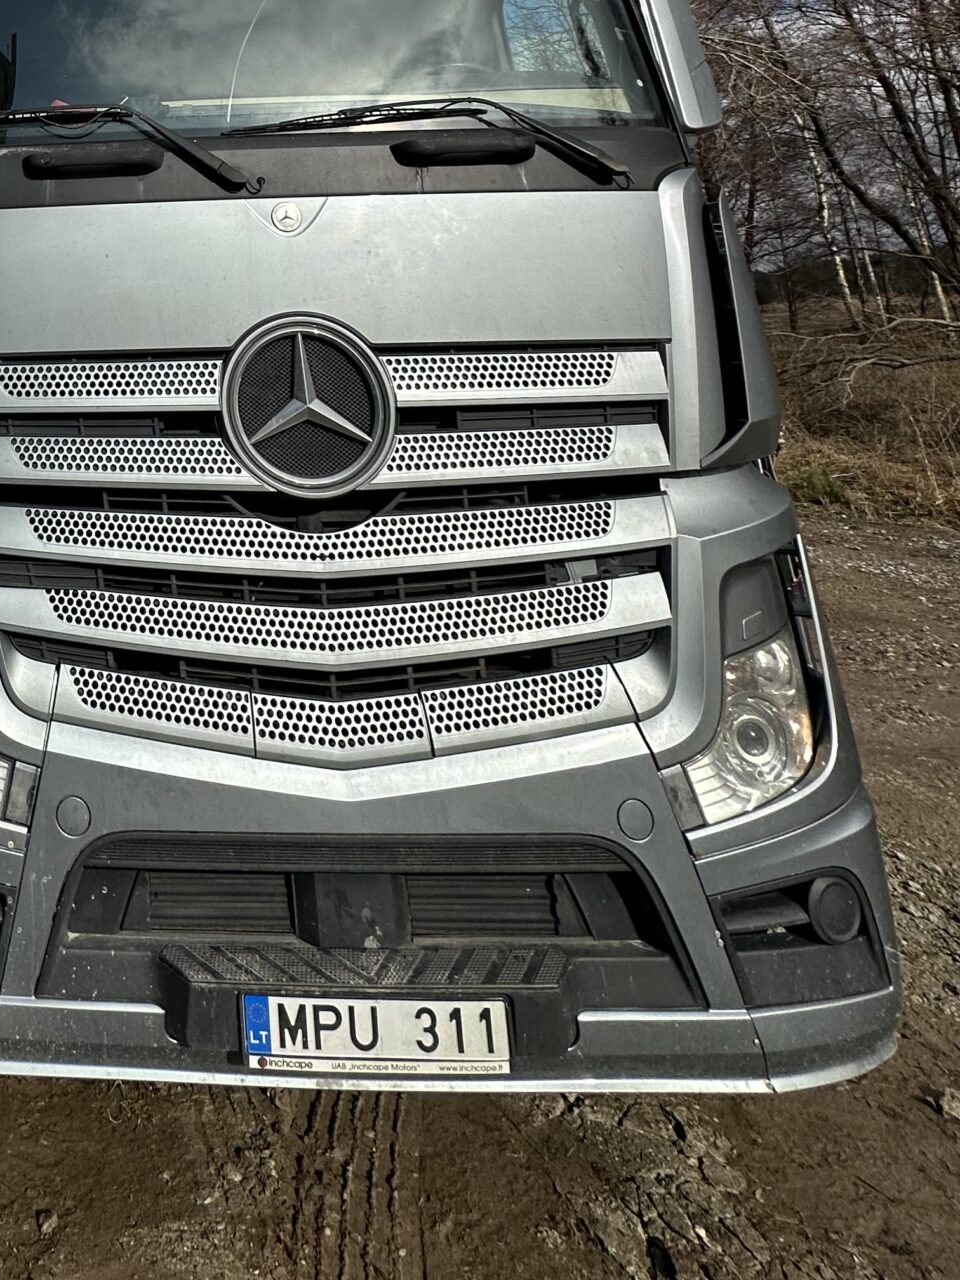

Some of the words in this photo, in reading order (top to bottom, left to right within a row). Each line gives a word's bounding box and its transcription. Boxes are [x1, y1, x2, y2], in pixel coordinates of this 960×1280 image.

[277, 1003, 379, 1052] MPU
[414, 1007, 495, 1054] 311
[249, 1030, 268, 1044] LT
[331, 1062, 346, 1070] UAB
[439, 1064, 503, 1072] www.inchcape.lt
